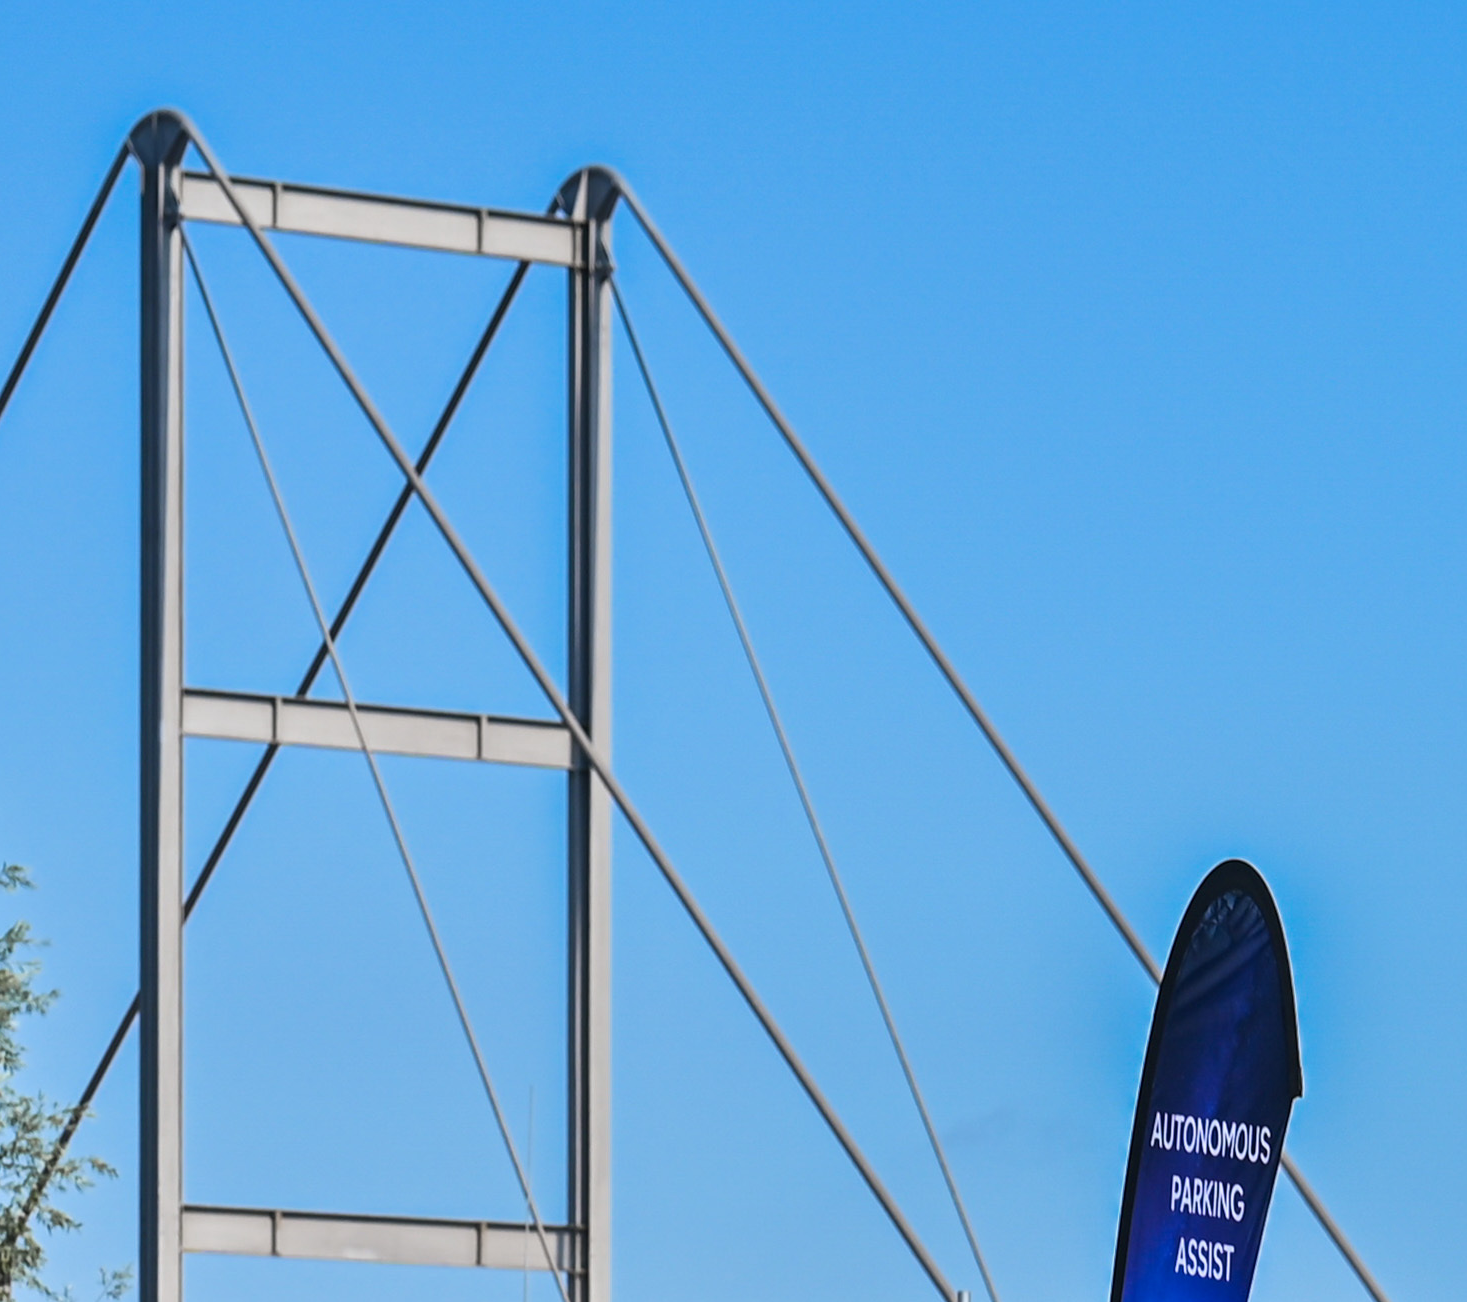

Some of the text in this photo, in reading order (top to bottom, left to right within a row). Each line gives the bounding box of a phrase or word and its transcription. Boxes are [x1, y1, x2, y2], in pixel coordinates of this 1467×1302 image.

[1150, 1111, 1272, 1165] AUTONOMOUS
[1171, 1174, 1245, 1222] PARKING
[1175, 1237, 1235, 1282] ASSIST
